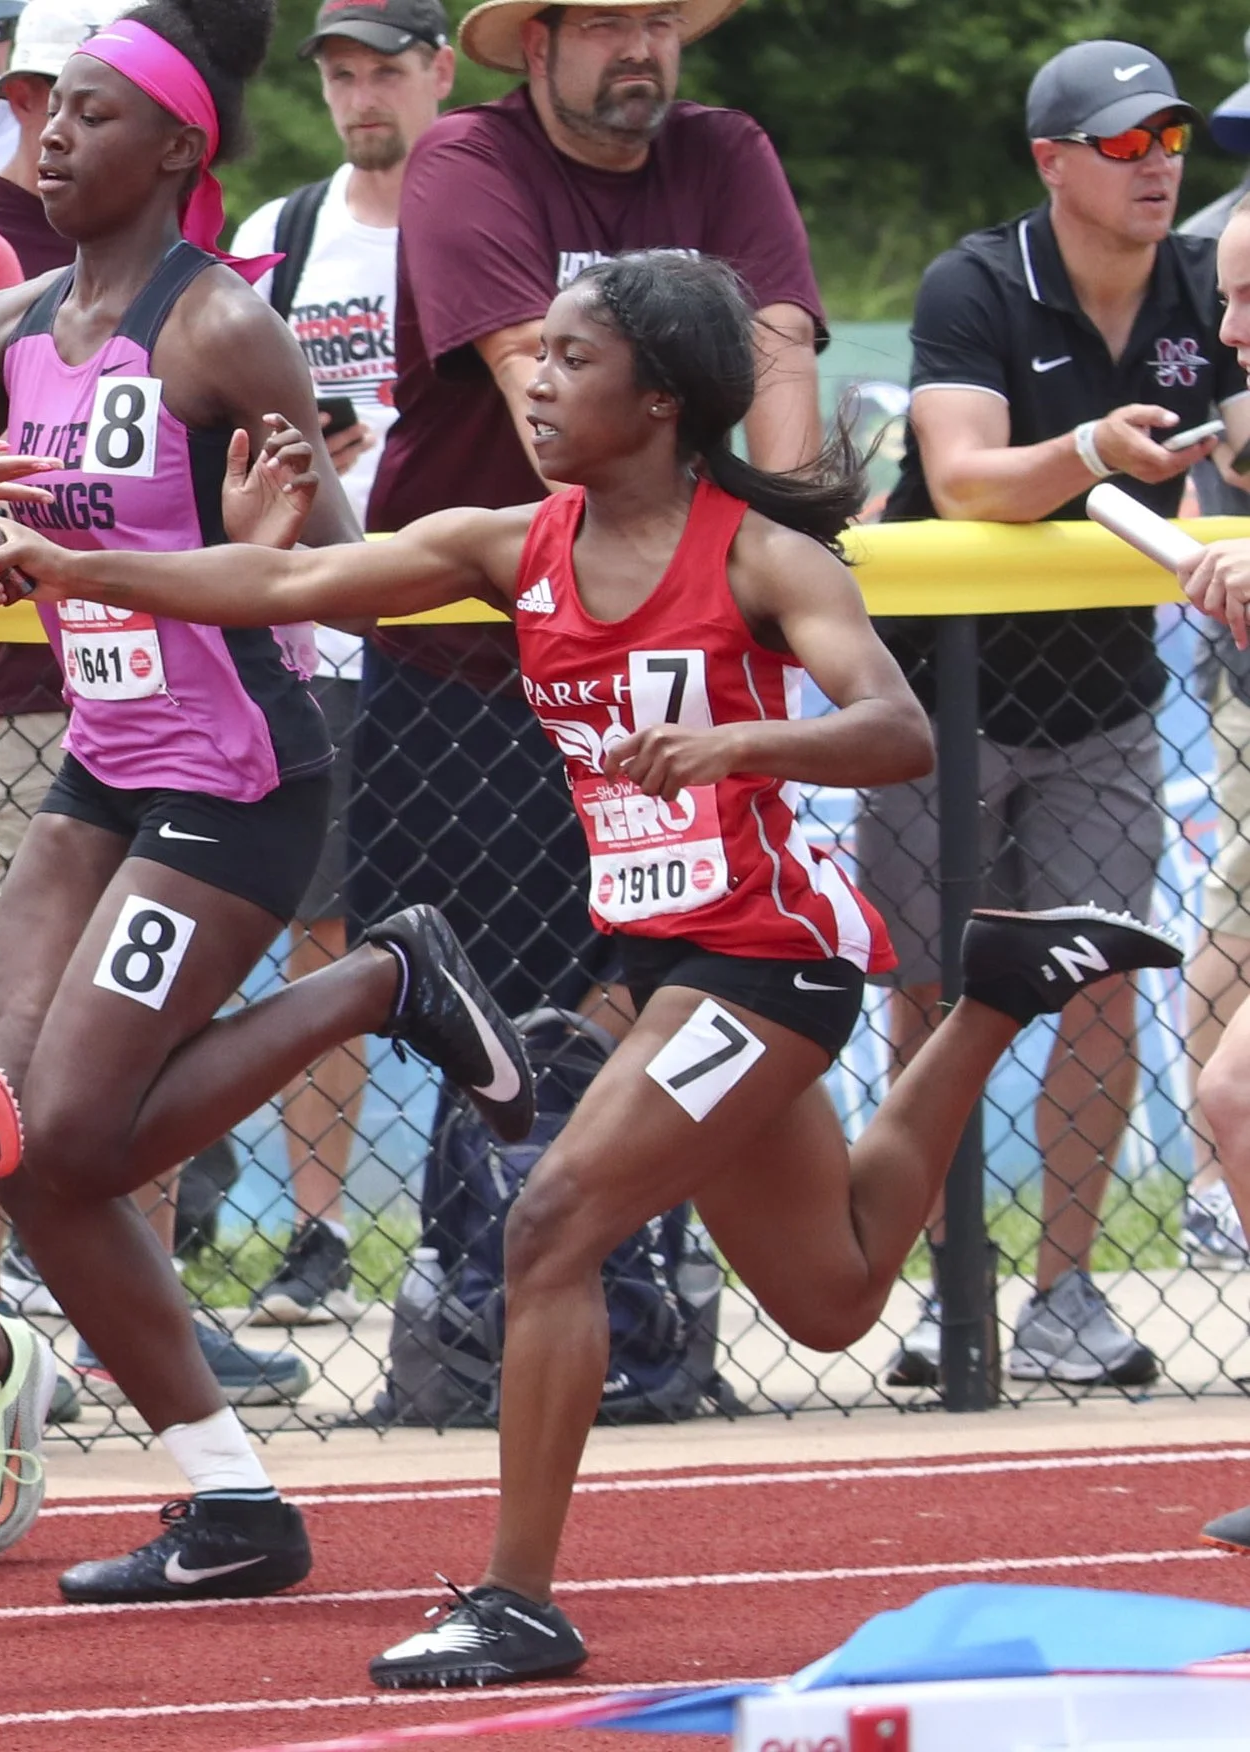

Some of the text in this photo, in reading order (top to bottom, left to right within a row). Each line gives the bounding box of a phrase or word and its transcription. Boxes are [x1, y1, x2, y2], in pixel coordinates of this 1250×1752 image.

[95, 384, 146, 468] 8
[8, 482, 115, 530] PRINGS
[516, 599, 556, 614] adidas
[75, 646, 123, 684] 1641
[522, 674, 608, 707] PARK
[647, 658, 689, 724] 7
[582, 787, 696, 843] ZERO
[617, 859, 687, 905] 1910
[110, 909, 177, 993] 8
[1048, 934, 1110, 983] N
[666, 1013, 749, 1091] 7
